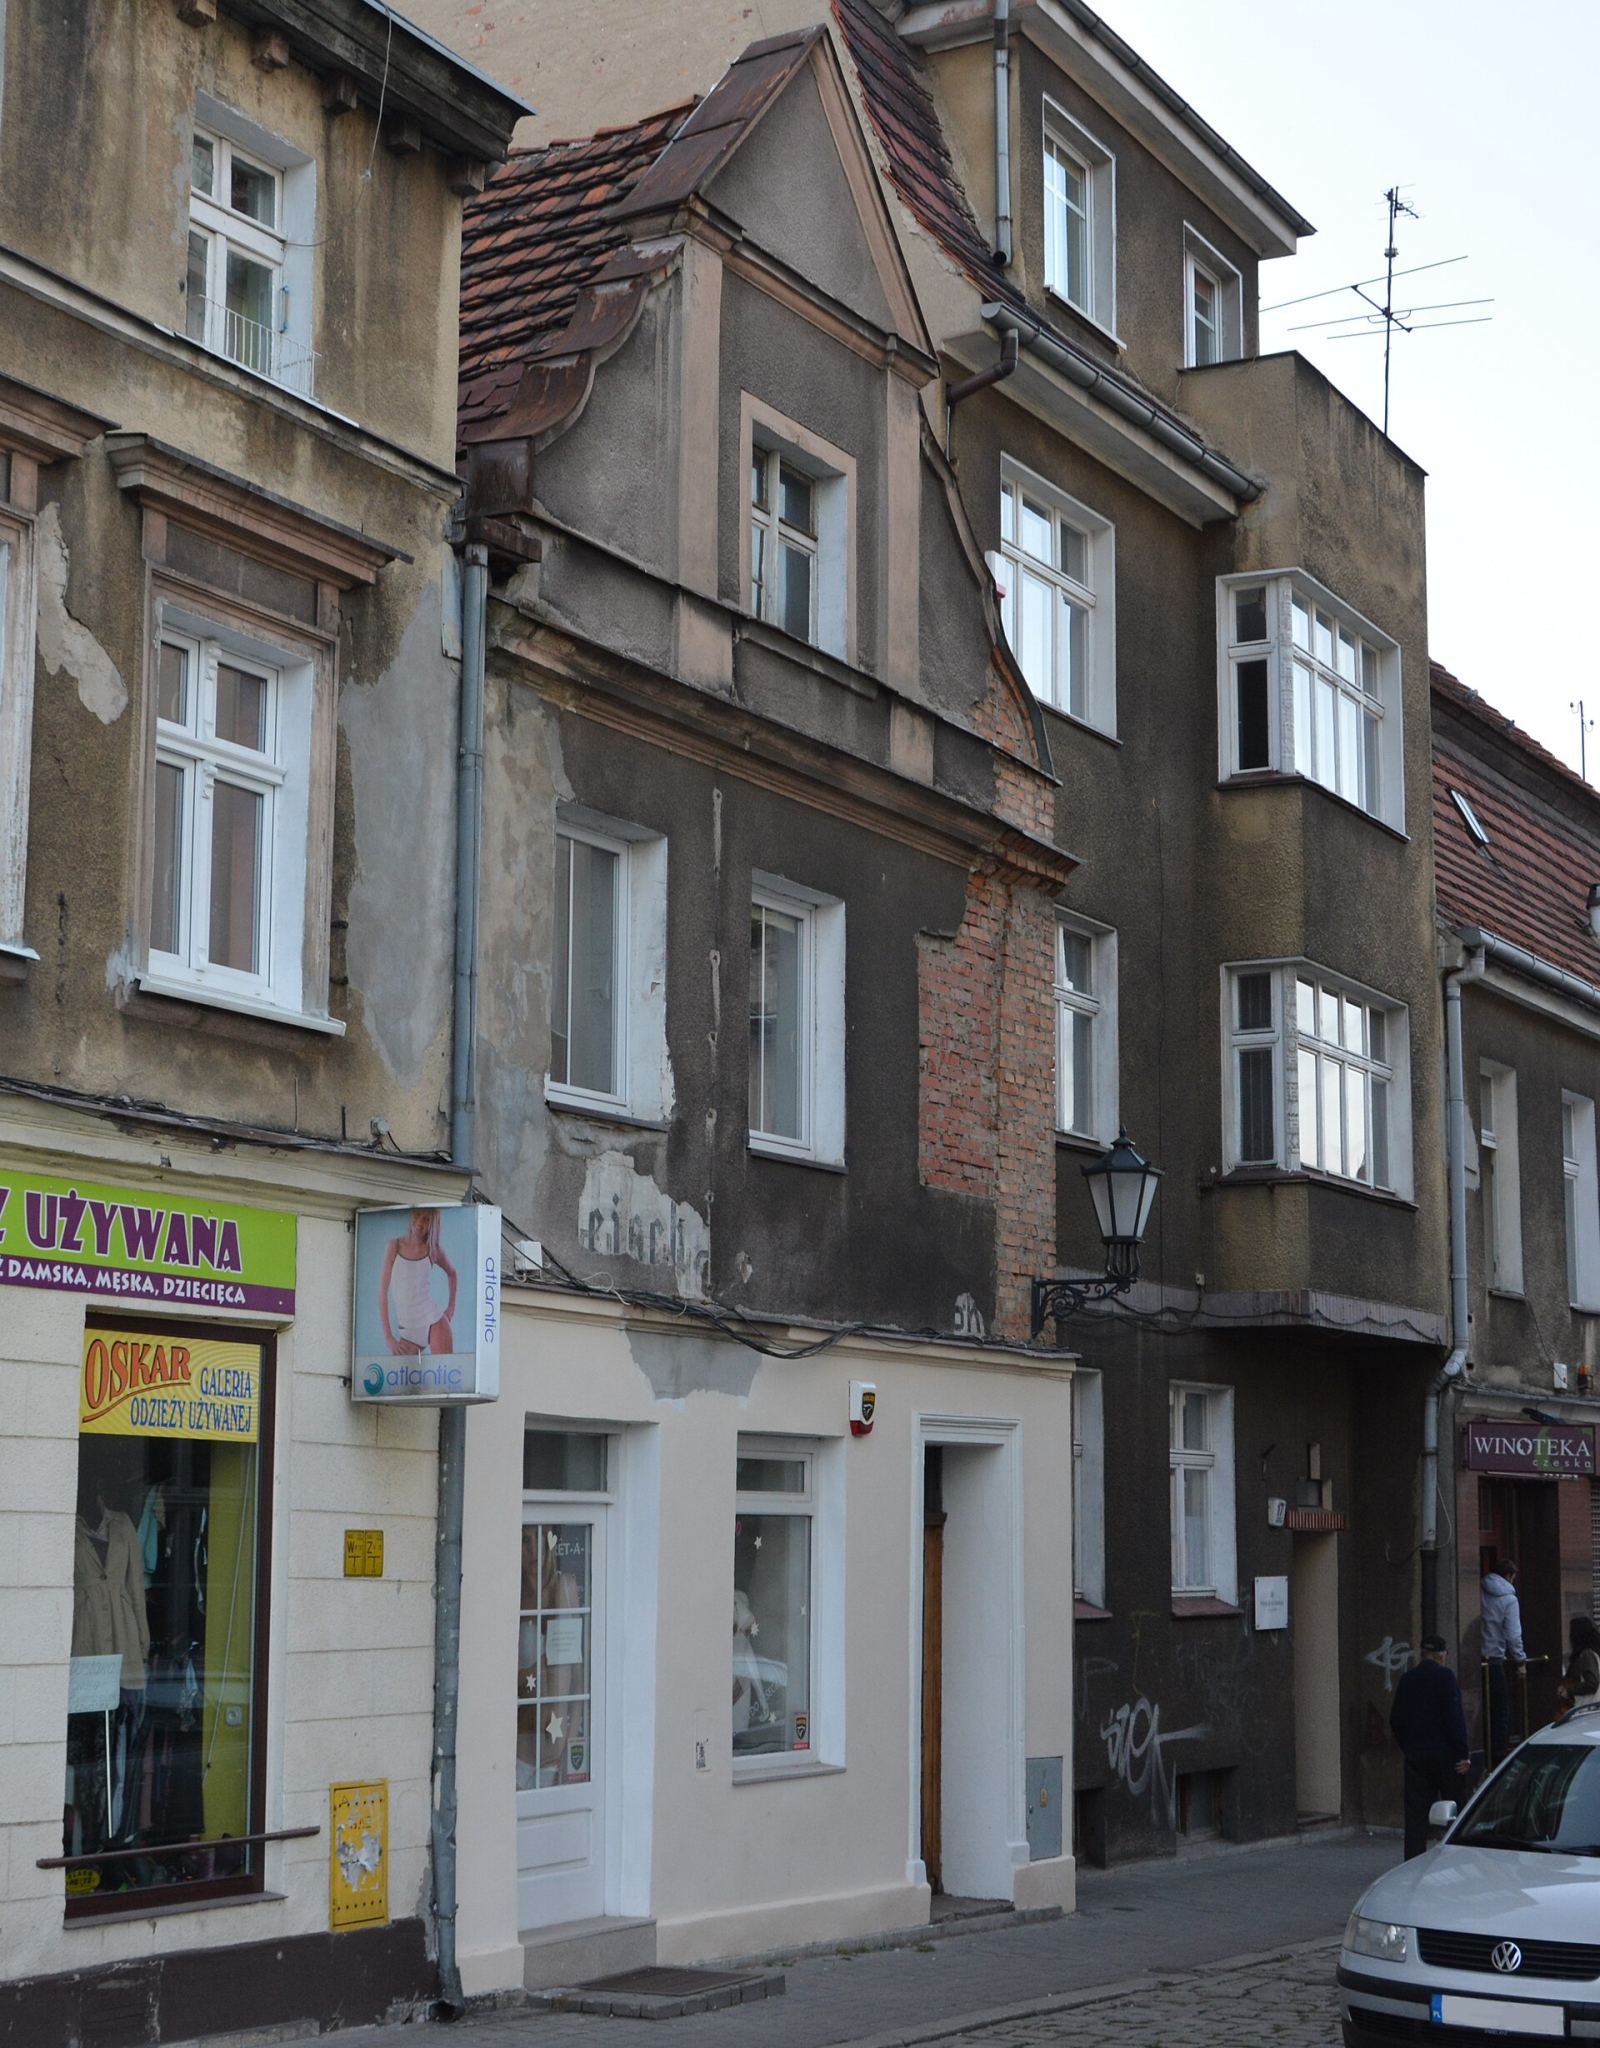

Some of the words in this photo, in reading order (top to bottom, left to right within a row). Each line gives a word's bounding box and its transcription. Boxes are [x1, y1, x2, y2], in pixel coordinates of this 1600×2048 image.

[25, 1188, 243, 1273] UŻYWANA
[8, 1260, 92, 1288] DAMSKA,
[96, 1270, 159, 1296] MĘSKA,
[163, 1280, 246, 1304] DZIECIĘCA
[484, 1256, 497, 1344] atlantic
[85, 1338, 191, 1410] OSKAR
[200, 1366, 252, 1399] GALERIA
[386, 1364, 462, 1387] atlantic
[130, 1395, 186, 1428] ODZIEŻY
[188, 1397, 252, 1433] UŻYWANEJ
[1474, 1437, 1592, 1457] WINOTEKA
[1532, 1458, 1591, 1468] czeska
